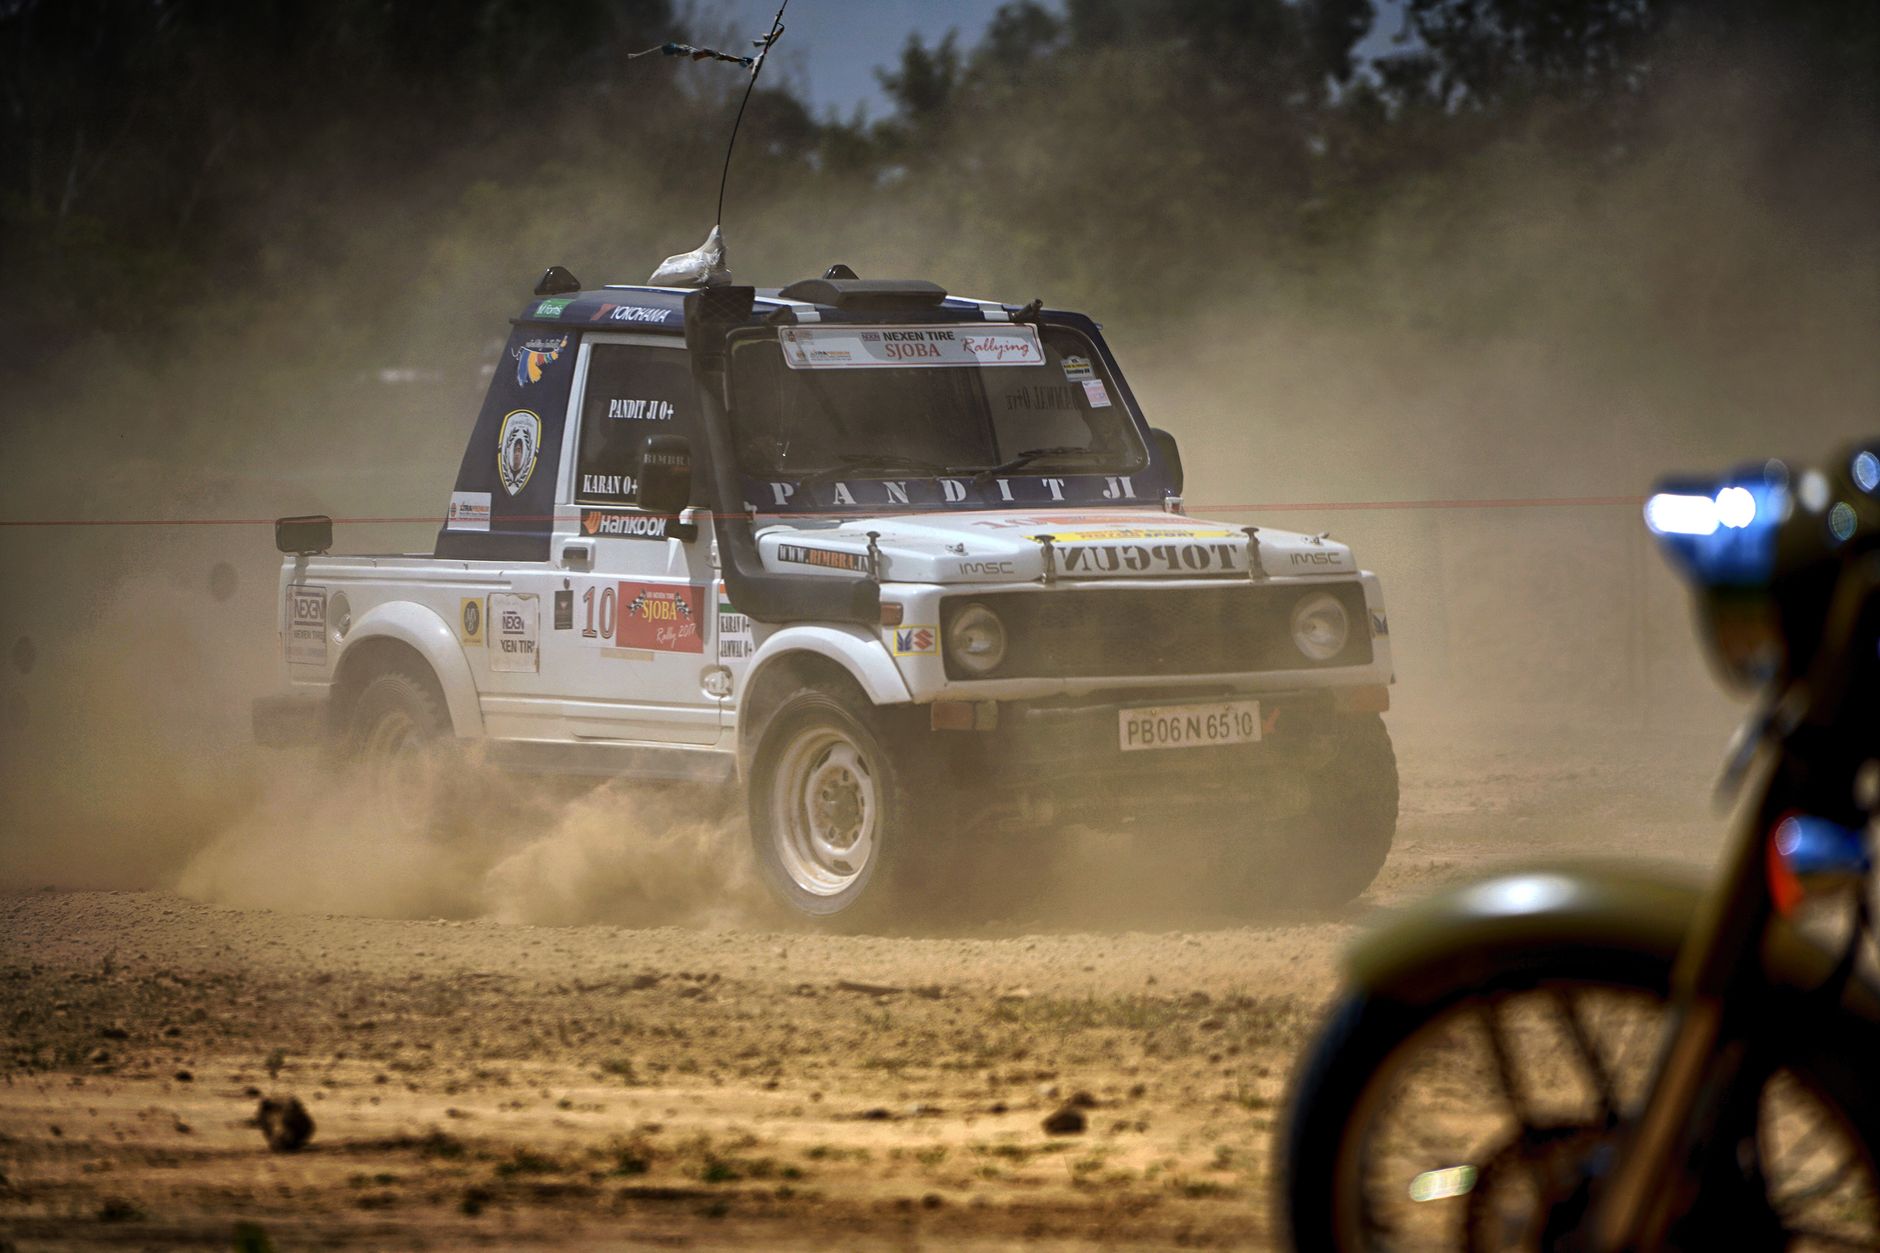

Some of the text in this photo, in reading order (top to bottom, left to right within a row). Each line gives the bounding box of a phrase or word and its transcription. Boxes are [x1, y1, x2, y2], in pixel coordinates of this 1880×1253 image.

[610, 305, 672, 323] YOKOHAMA
[883, 331, 924, 342] NEXEN
[926, 331, 956, 342] TIRE
[885, 342, 942, 360] SJOBA
[960, 335, 1030, 360] Rallying
[608, 399, 647, 419] PANDIT
[646, 400, 659, 420] JI
[583, 474, 621, 494] KARAN
[1102, 476, 1137, 499] JI
[959, 561, 1015, 575] IMSC
[1290, 552, 1343, 567] IMSC
[582, 586, 617, 640] 10
[642, 599, 678, 623] SJOBA
[720, 615, 741, 633] KARAN
